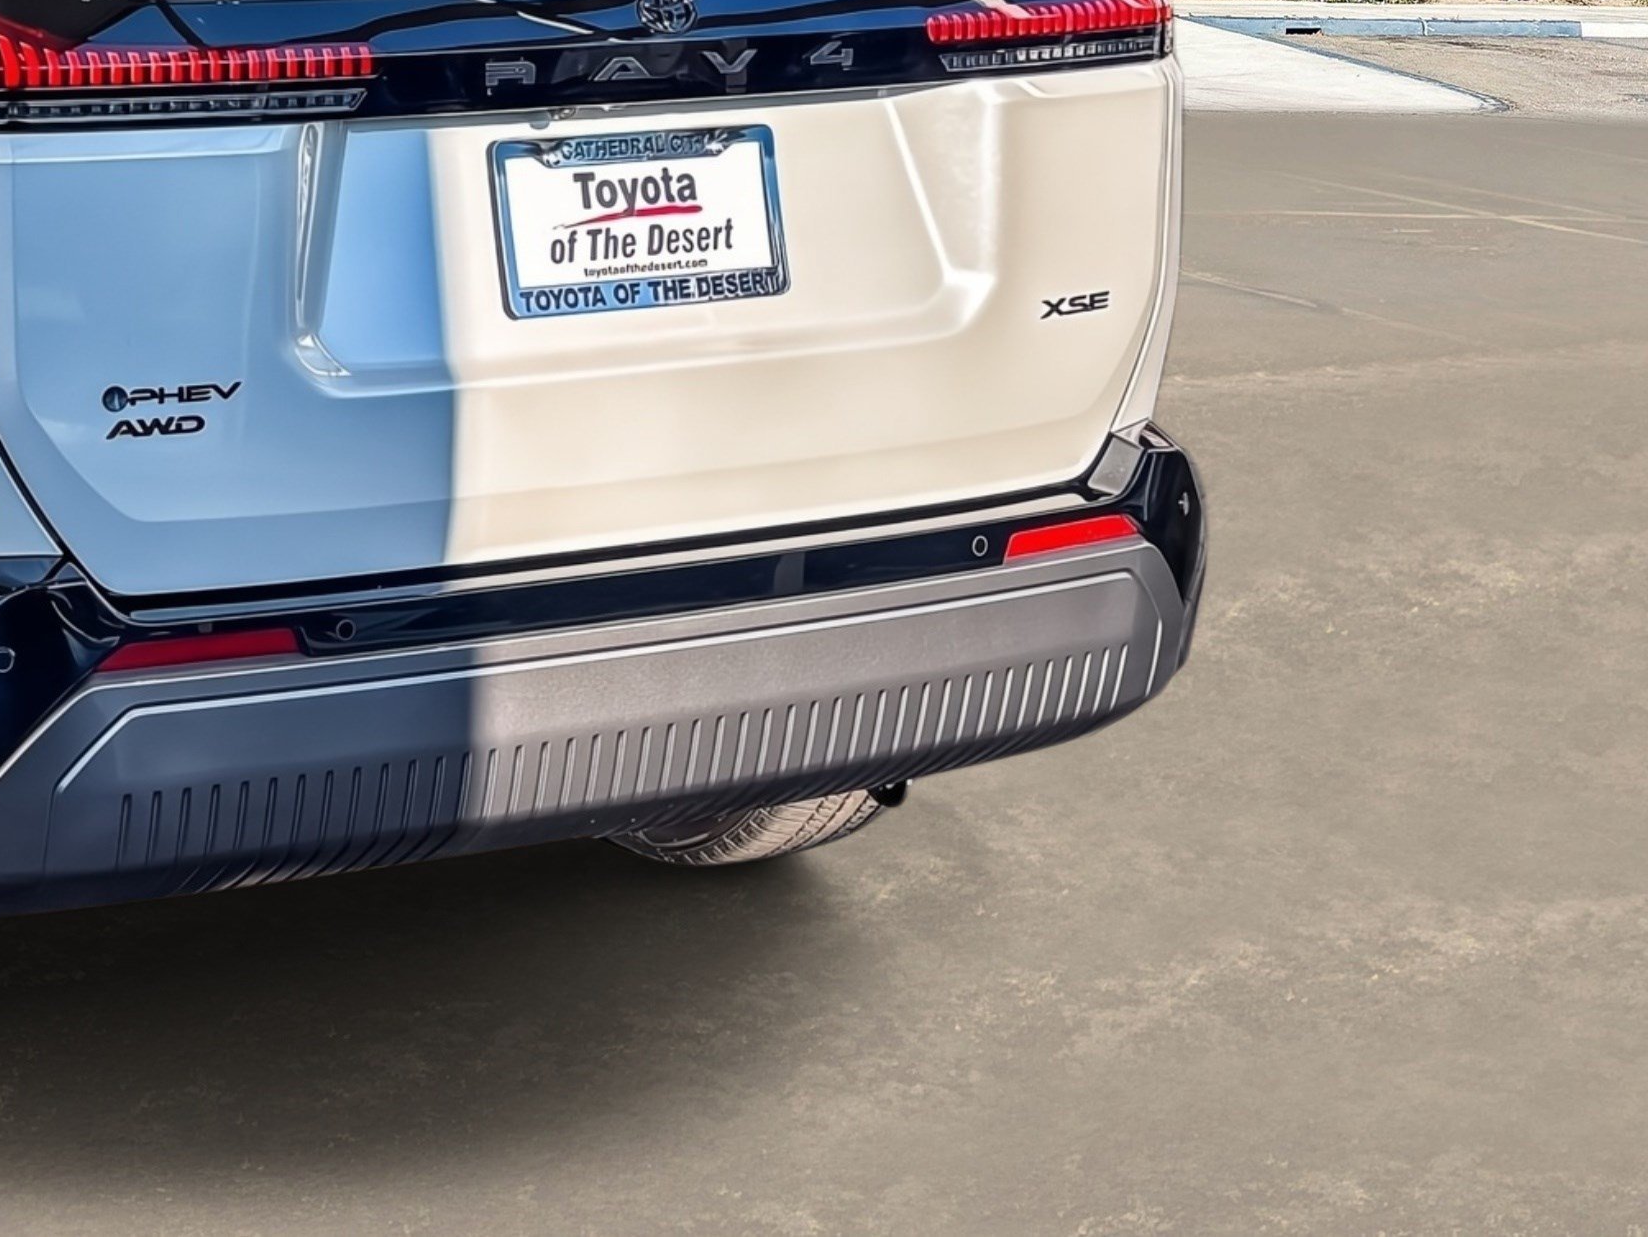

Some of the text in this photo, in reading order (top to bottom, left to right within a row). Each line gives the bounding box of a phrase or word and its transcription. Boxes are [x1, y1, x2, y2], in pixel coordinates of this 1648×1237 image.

[561, 133, 665, 161] CATHEDRAL
[573, 167, 698, 217] Toyota
[550, 218, 733, 264] of The Desert
[583, 258, 709, 279] toyotaofthedesert.com
[519, 286, 607, 313] TOYOTA
[612, 282, 642, 306] OF
[699, 268, 780, 297] DESERT
[1040, 290, 1111, 319] XSE
[106, 415, 206, 440] AWD
